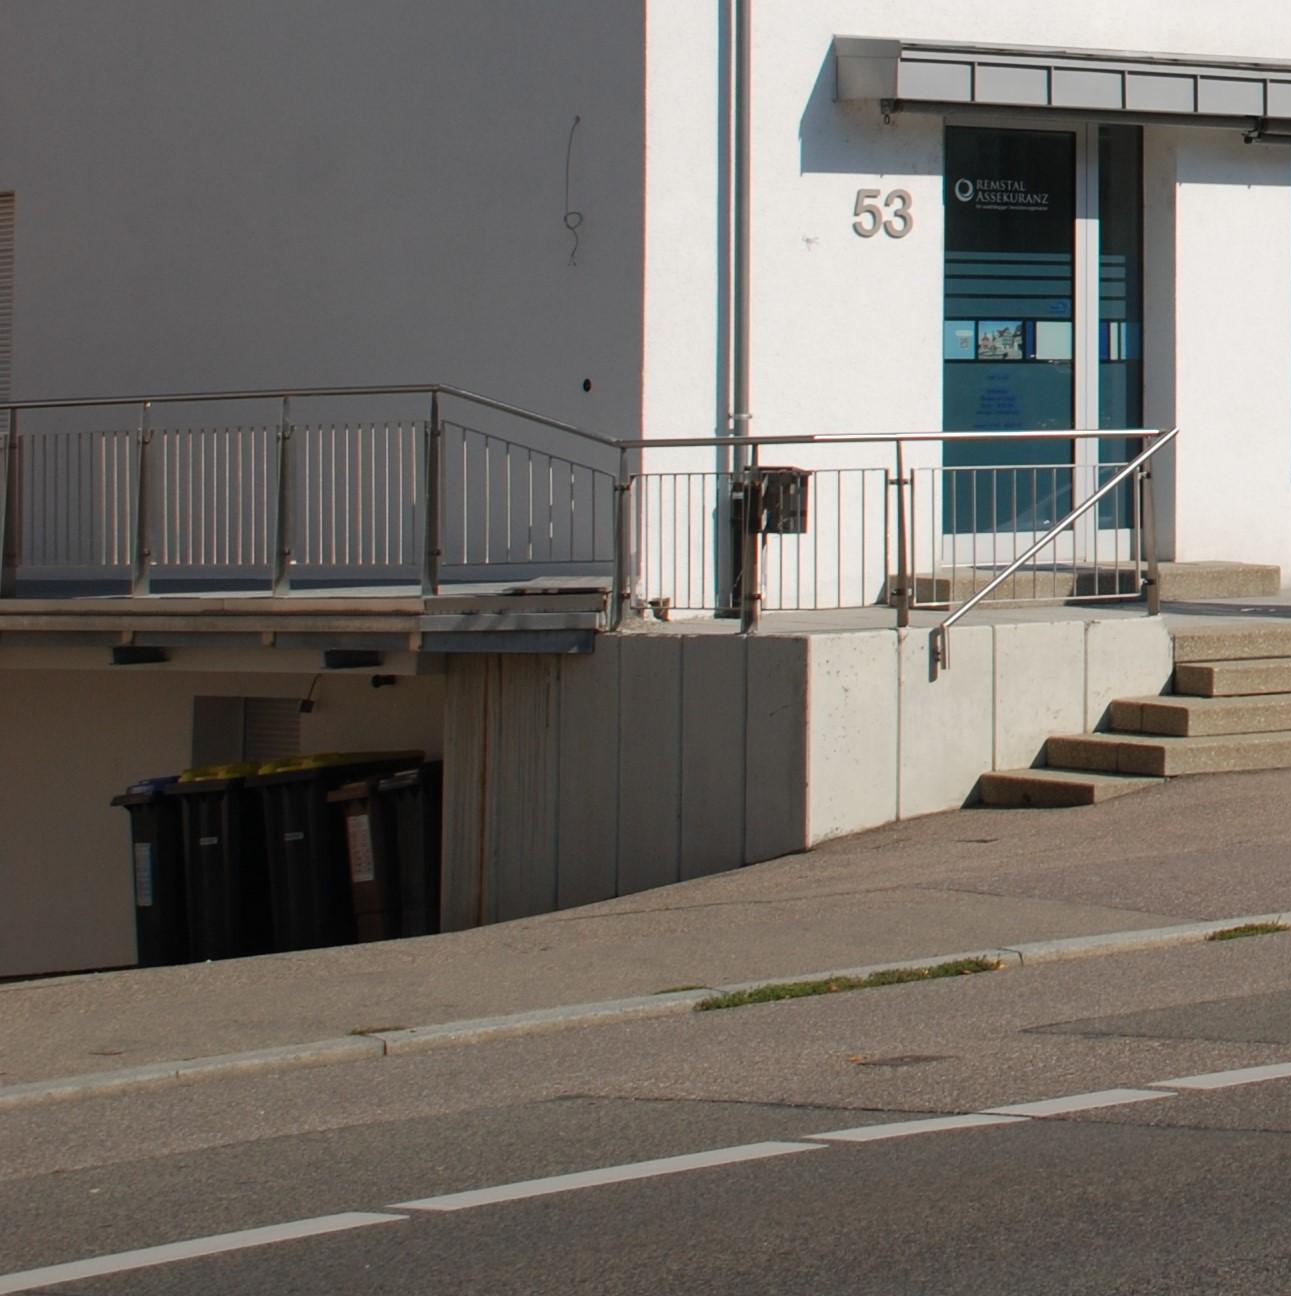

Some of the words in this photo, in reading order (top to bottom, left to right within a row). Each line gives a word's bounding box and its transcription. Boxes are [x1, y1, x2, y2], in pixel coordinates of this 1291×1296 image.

[976, 179, 1026, 191] REMSTAL
[975, 191, 1049, 204] ASSEKURANZ
[852, 188, 914, 239] 53
